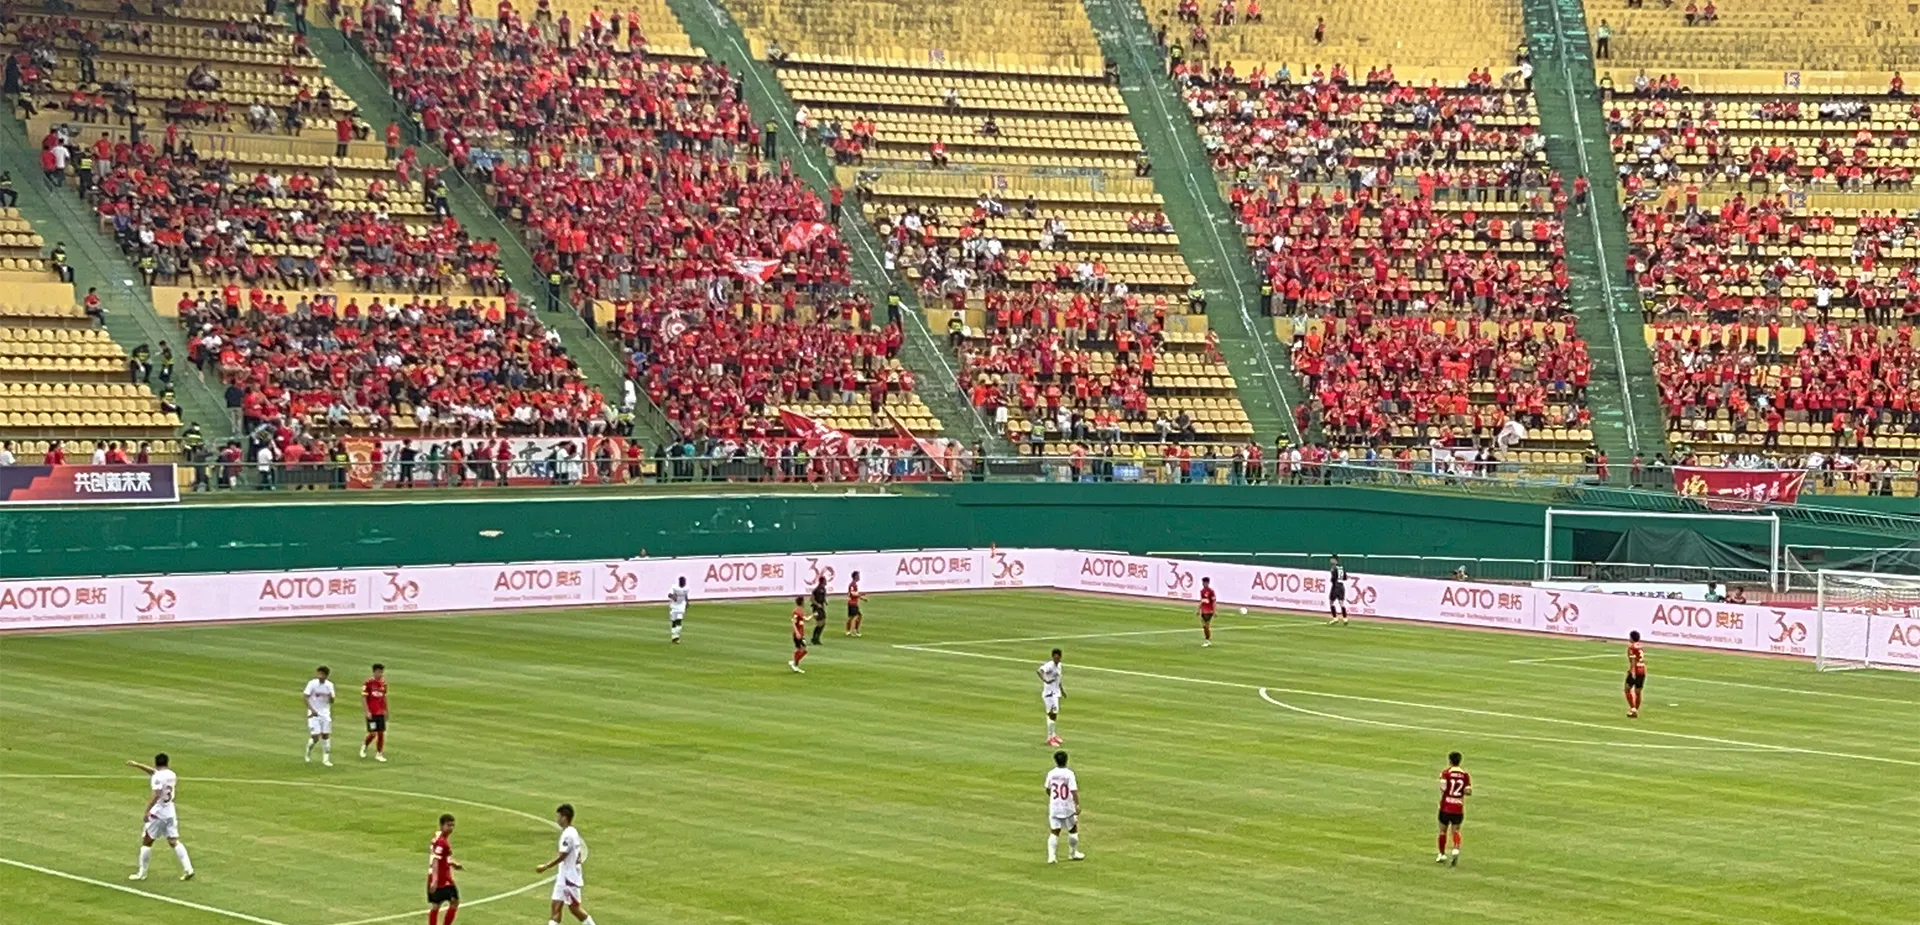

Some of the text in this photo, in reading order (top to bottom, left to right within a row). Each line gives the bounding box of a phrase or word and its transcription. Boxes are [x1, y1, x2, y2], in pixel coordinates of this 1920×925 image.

[704, 562, 758, 583] AOTO
[895, 556, 946, 575] AOTO
[1080, 557, 1126, 578] AOTO
[259, 577, 324, 600] AOTO
[494, 569, 553, 591] AOTO
[1251, 571, 1301, 593] AOTO
[0, 586, 71, 609] AOTO
[1440, 586, 1495, 610] AOTO
[1651, 603, 1713, 629] AOTO
[1052, 782, 1069, 801] 30
[1449, 779, 1464, 796] 12
